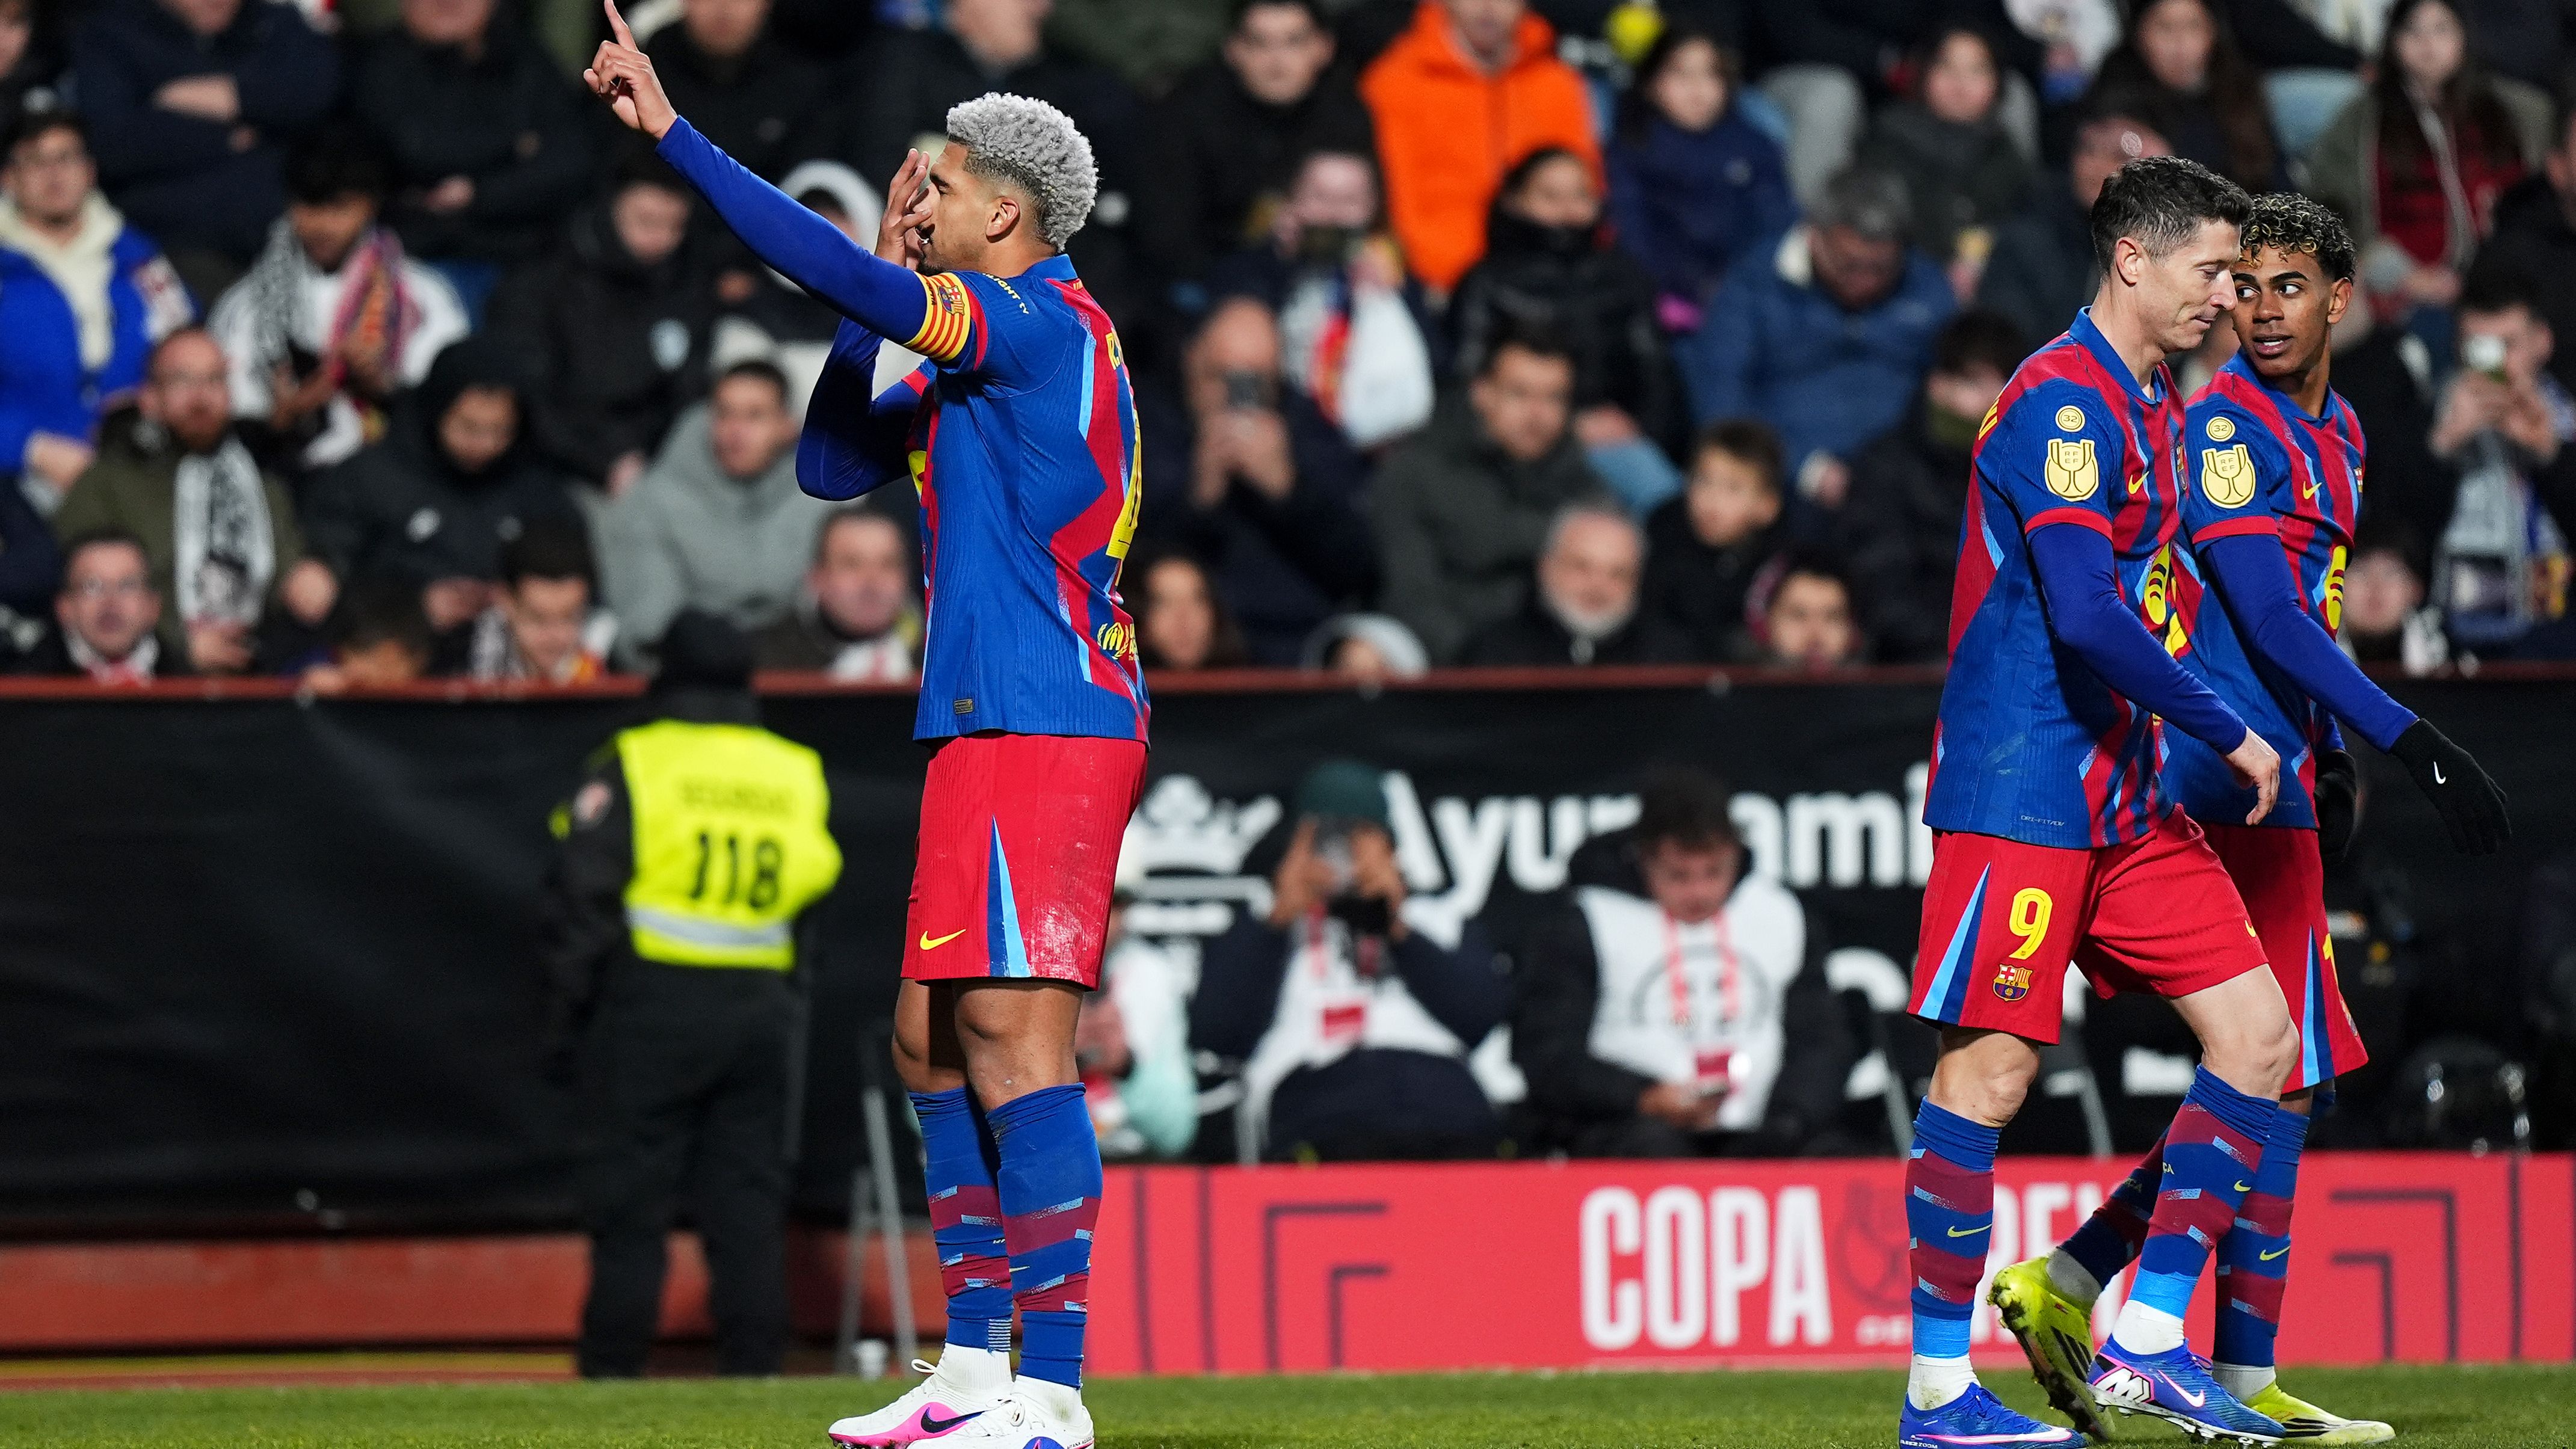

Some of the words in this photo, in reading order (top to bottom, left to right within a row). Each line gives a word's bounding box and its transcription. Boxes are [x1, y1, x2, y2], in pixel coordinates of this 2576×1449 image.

[2063, 414, 2077, 423] 32
[689, 829, 783, 911] 118
[2009, 887, 2053, 960] 9
[1579, 1186, 1834, 1350] COPA
